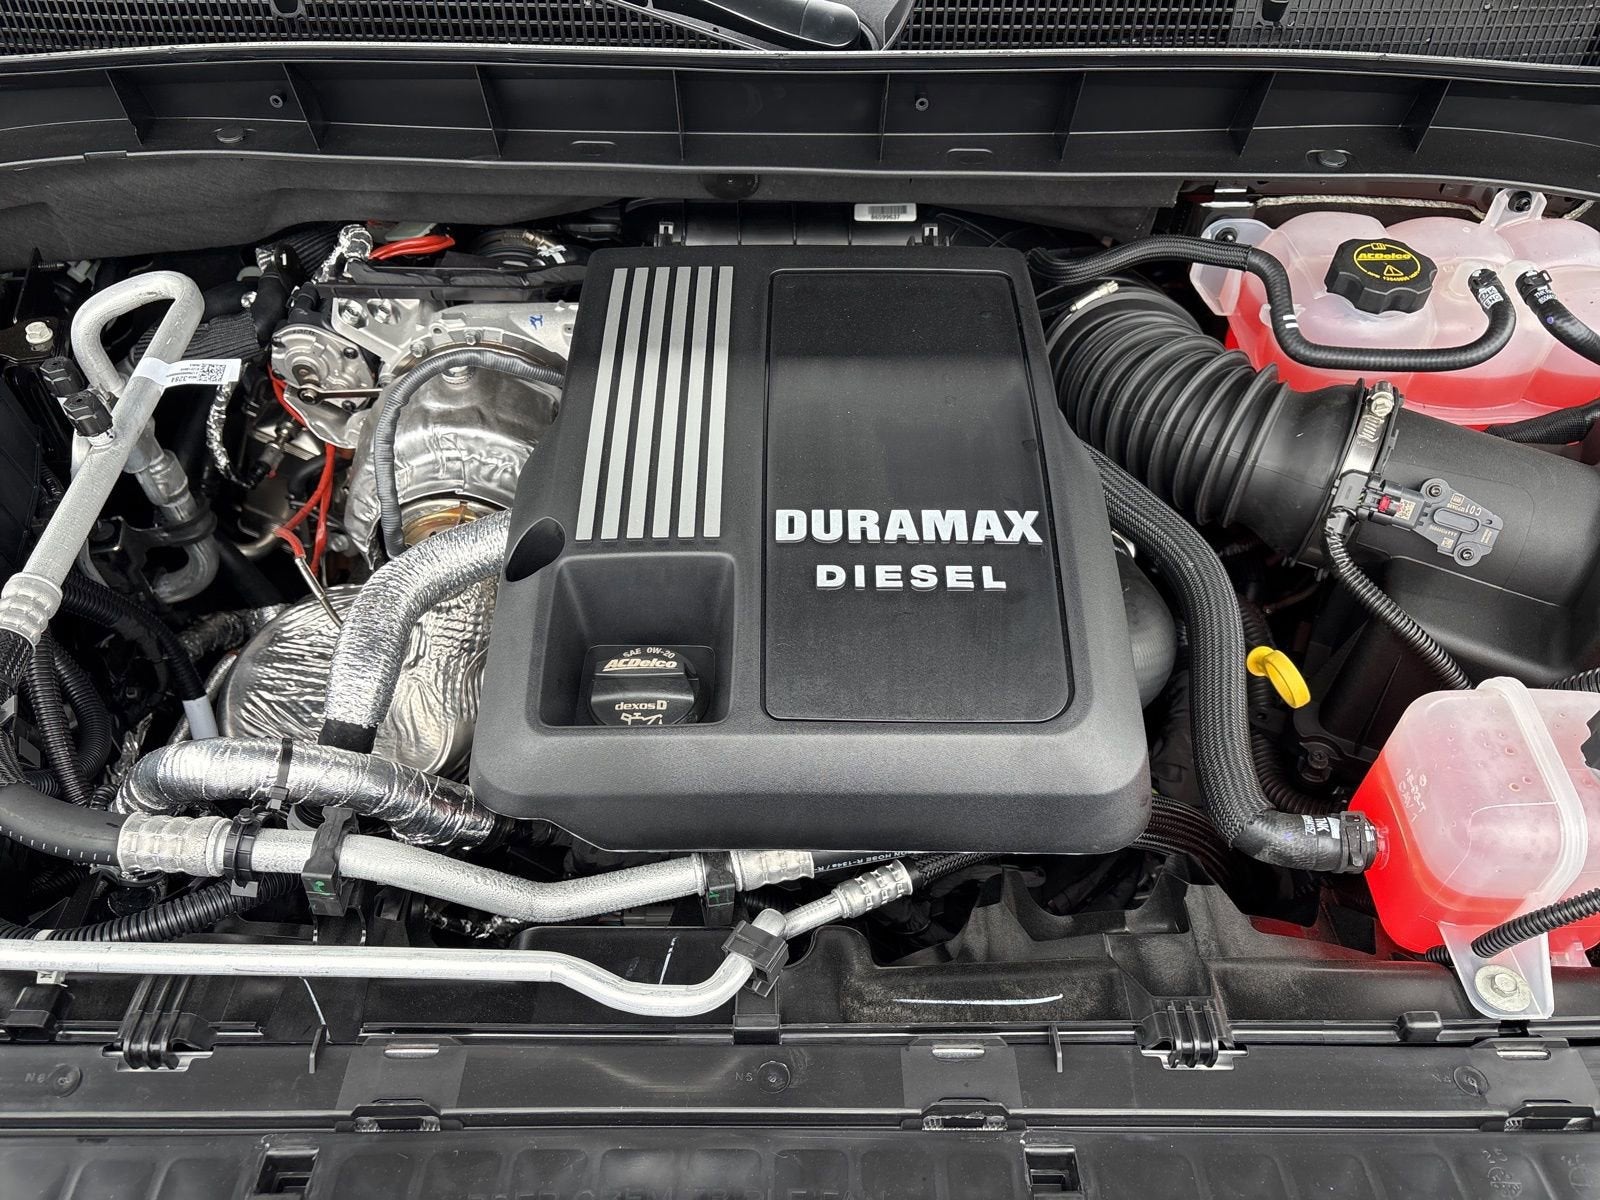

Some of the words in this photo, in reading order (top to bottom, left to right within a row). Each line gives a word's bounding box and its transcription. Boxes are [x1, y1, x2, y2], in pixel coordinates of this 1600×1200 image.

[1357, 252, 1412, 261] ACDelco
[775, 509, 1043, 545] DURAMAX
[816, 564, 1007, 592] DIESEL
[623, 647, 642, 658] SAE
[646, 646, 676, 659] 0W-20
[602, 658, 678, 671] ACDelco
